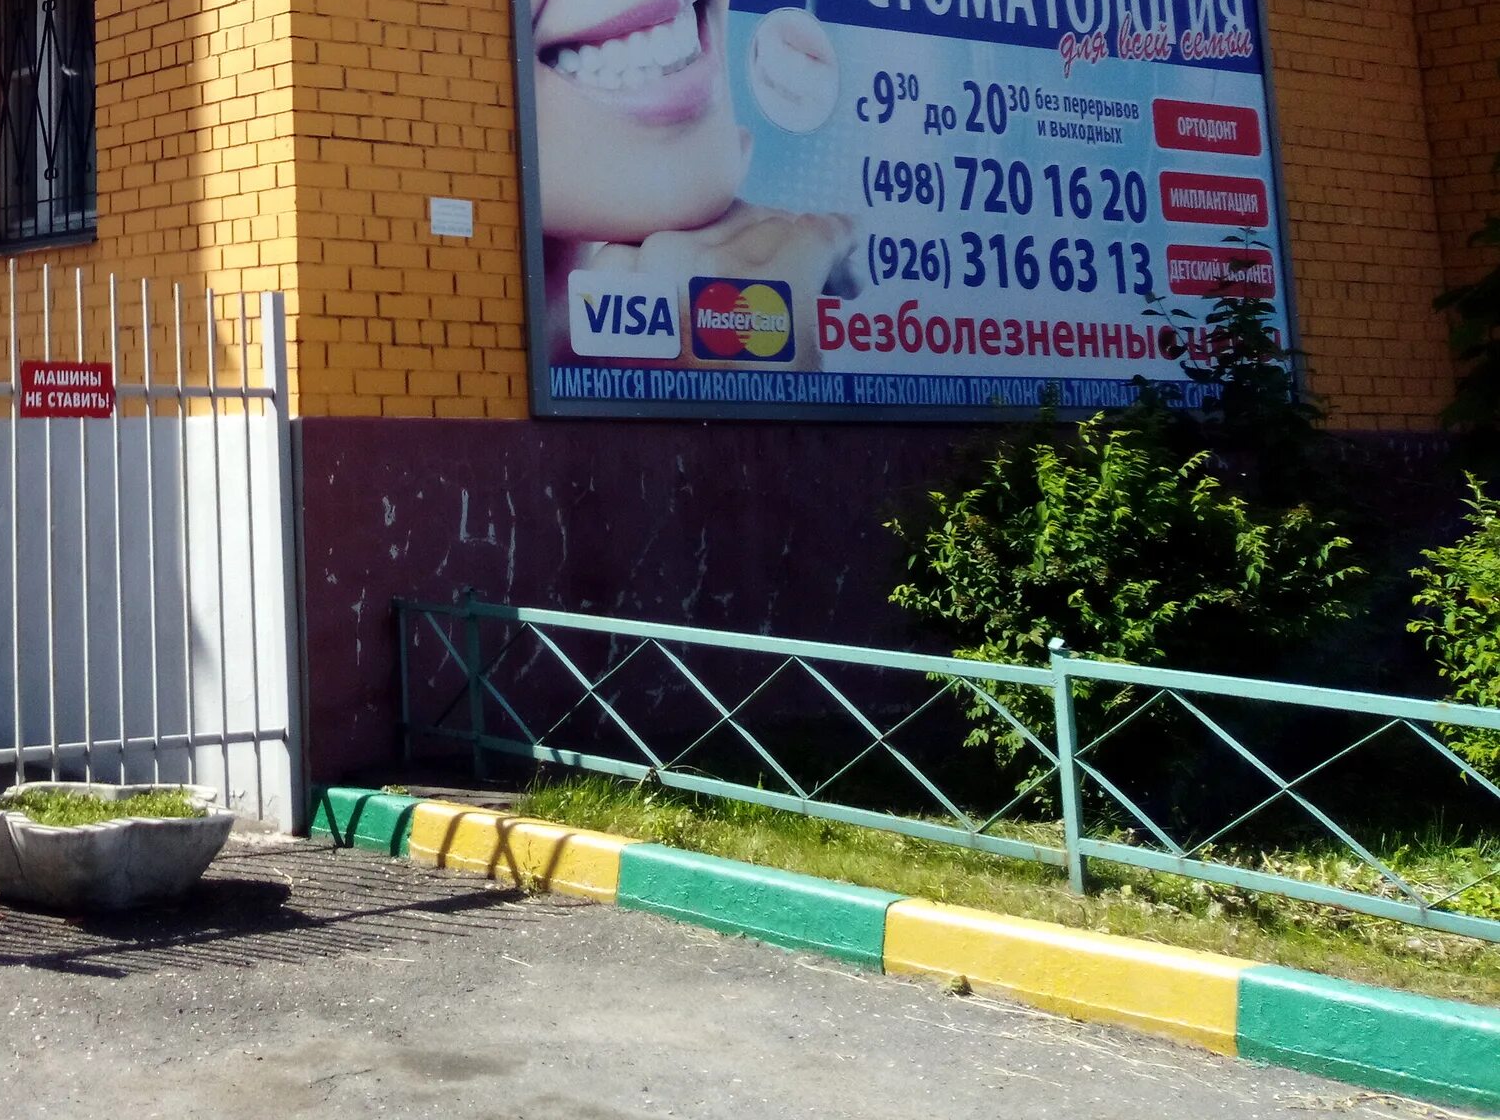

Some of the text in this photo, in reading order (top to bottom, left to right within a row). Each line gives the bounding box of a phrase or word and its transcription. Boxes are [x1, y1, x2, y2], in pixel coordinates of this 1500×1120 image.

[1059, 11, 1253, 79] для всей семьи
[856, 95, 870, 122] с
[924, 102, 956, 136] до
[1035, 87, 1059, 112] без
[1064, 95, 1140, 119] перерывов
[1050, 122, 1122, 144] выходных
[1177, 116, 1237, 141] ОРТОДОНТ
[863, 156, 1147, 223] (498) 720 16 20
[1170, 187, 1258, 215] ИМПЛАНТАЦИЯ
[869, 231, 1154, 295] (926) 316 63 13
[1170, 259, 1220, 282] ДЕТСКИЙ
[583, 294, 675, 336] VISA
[697, 309, 786, 333] MasterCard
[34, 370, 101, 386] МАШИНЫ
[550, 367, 645, 399] ИМЕЮТСЯ
[854, 376, 967, 406] НЕОБХОДИМО
[26, 392, 109, 408] НЕ СТАВИТЬ!
